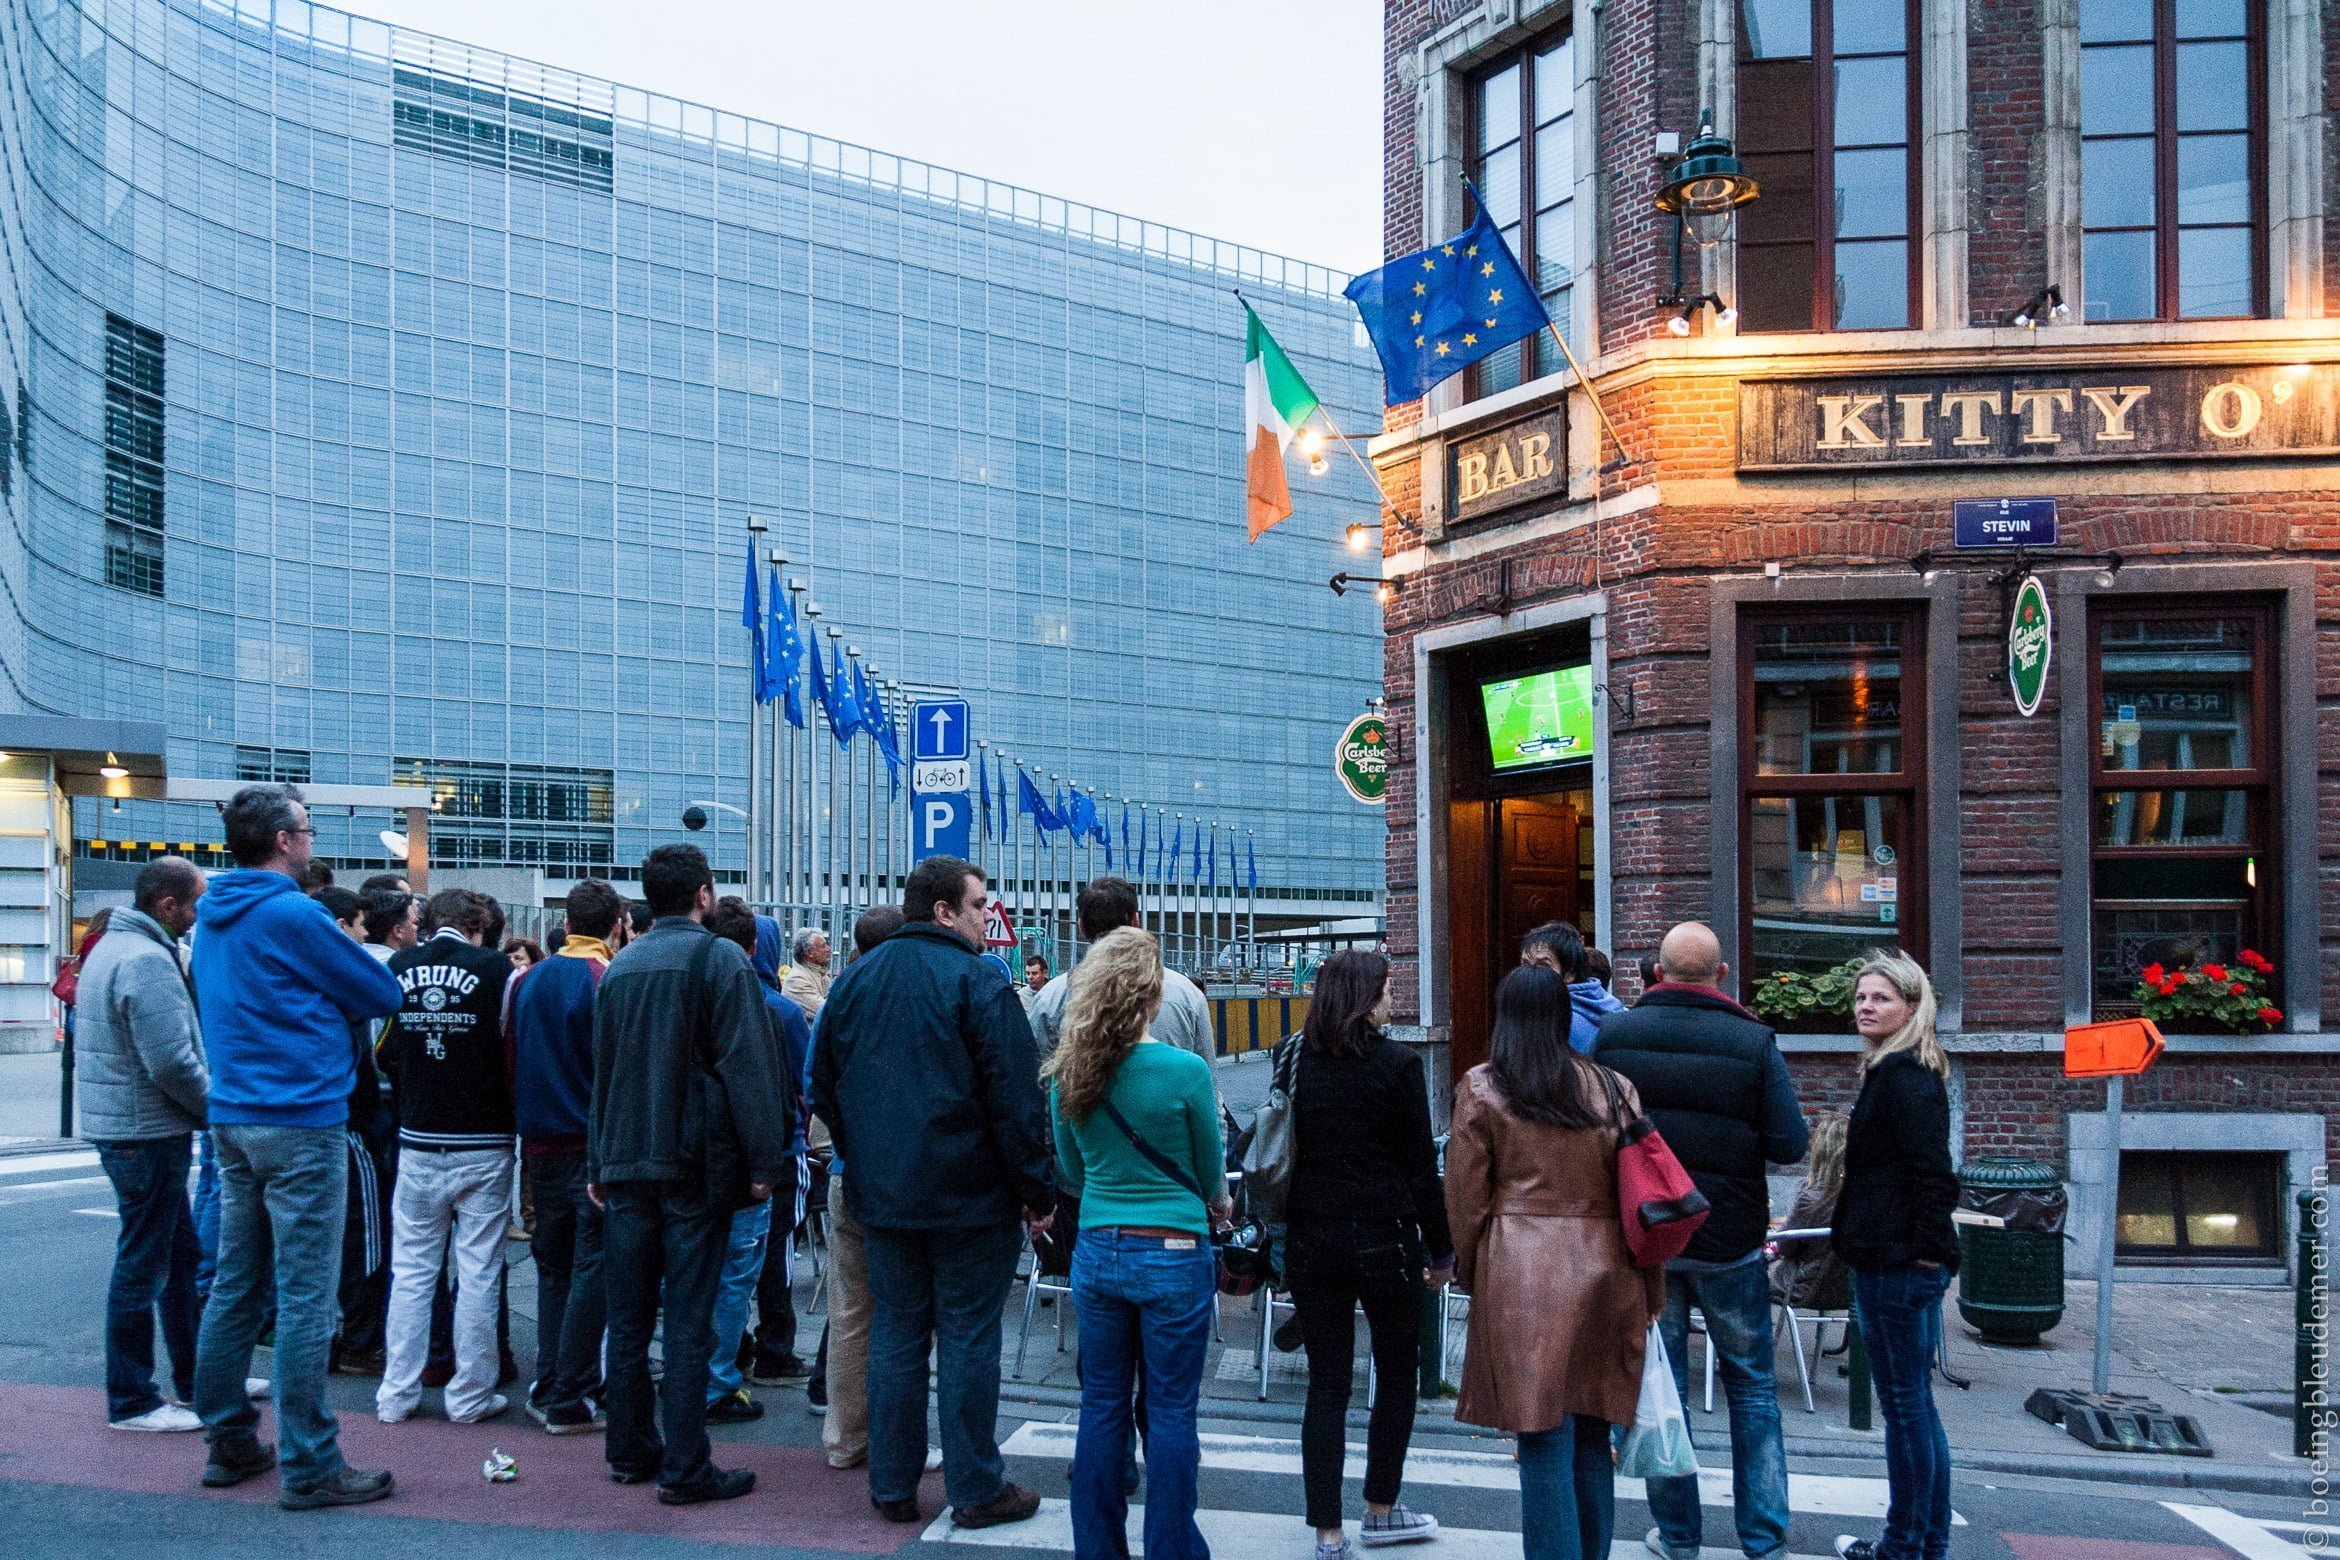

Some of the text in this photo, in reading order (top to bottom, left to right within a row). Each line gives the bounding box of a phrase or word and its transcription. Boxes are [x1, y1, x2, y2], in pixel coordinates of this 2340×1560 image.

[1816, 385, 2151, 449] KITTY
[1457, 431, 1554, 504] BAR
[1982, 519, 2031, 533] STEVIN
[2014, 624, 2047, 656] Carlsberg
[2021, 651, 2040, 671] Beer
[1359, 762, 1388, 773] Beer
[925, 801, 954, 848] P
[396, 965, 480, 995] WRUNG
[398, 1012, 477, 1025] INDEPENDENTS
